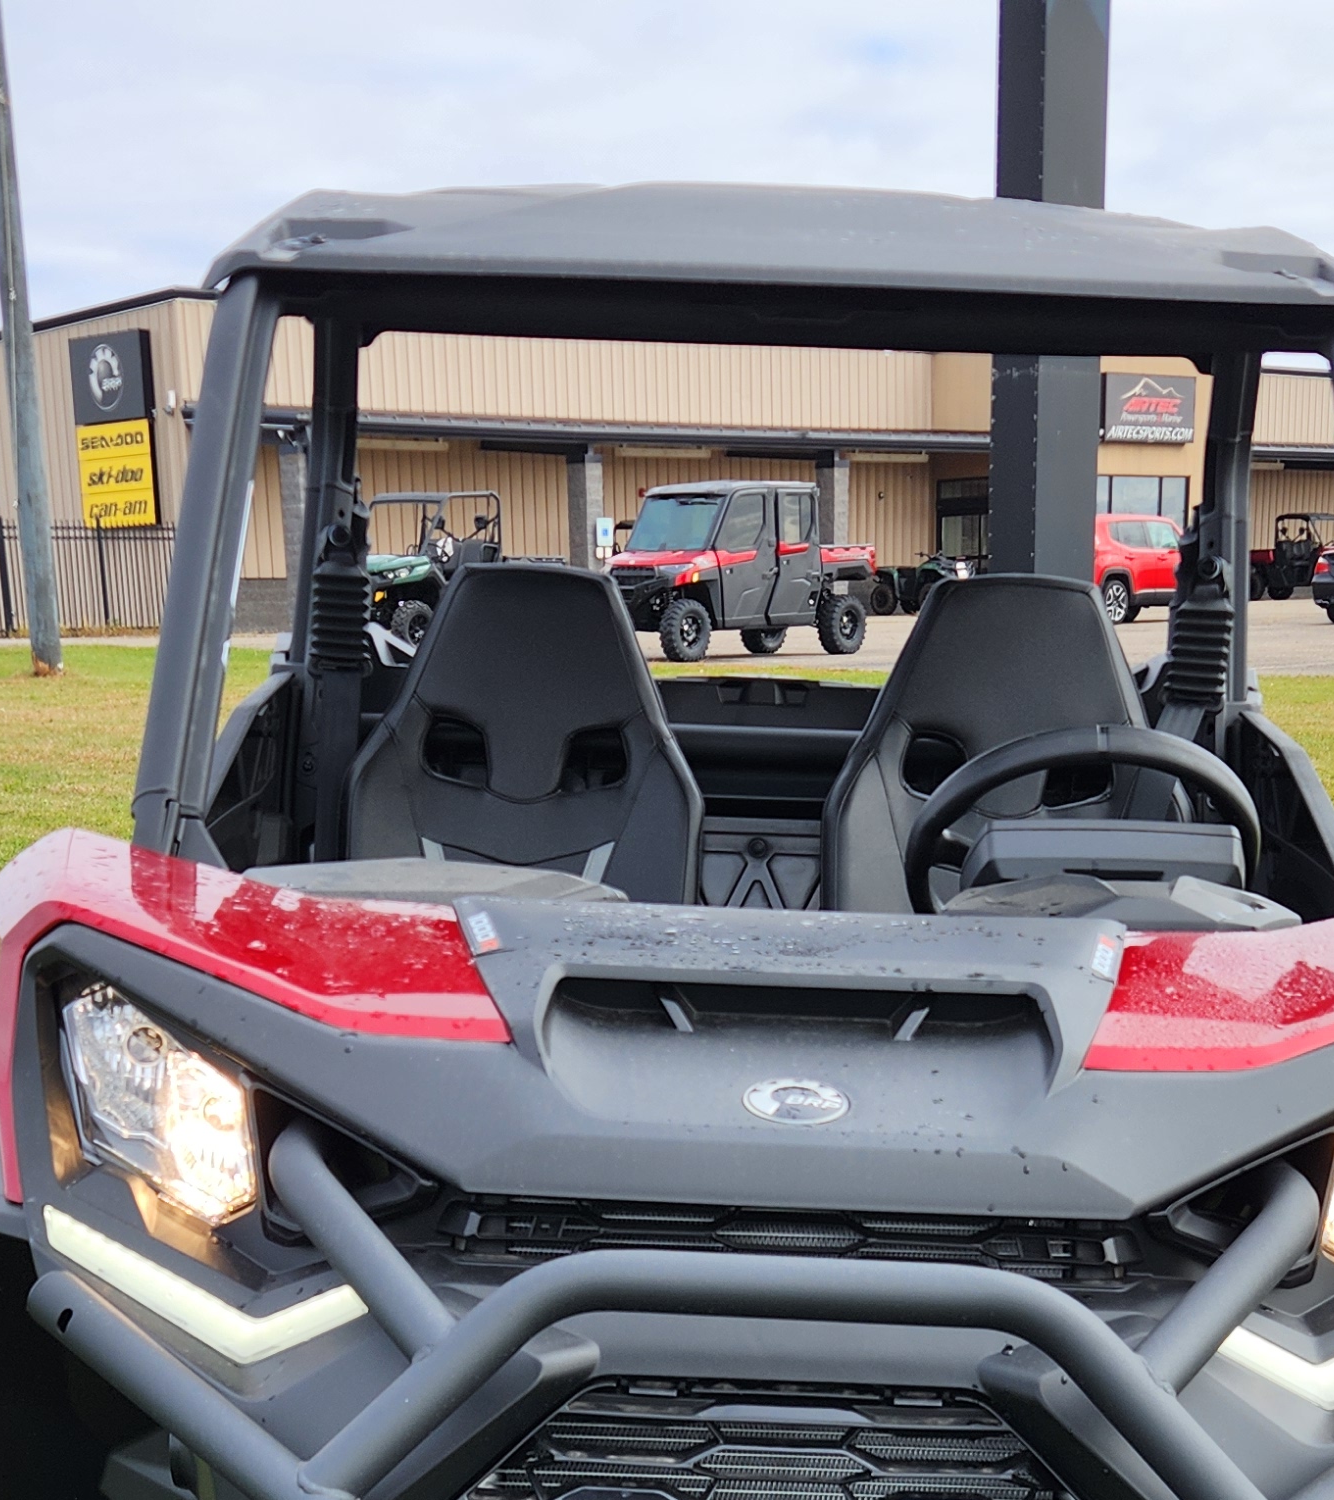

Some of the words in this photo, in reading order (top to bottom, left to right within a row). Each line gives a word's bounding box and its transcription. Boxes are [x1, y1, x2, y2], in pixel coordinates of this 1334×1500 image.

[1107, 425, 1194, 440] AIRTECSPORTS.COM
[88, 464, 143, 487] ski-doo
[89, 499, 148, 519] can-am
